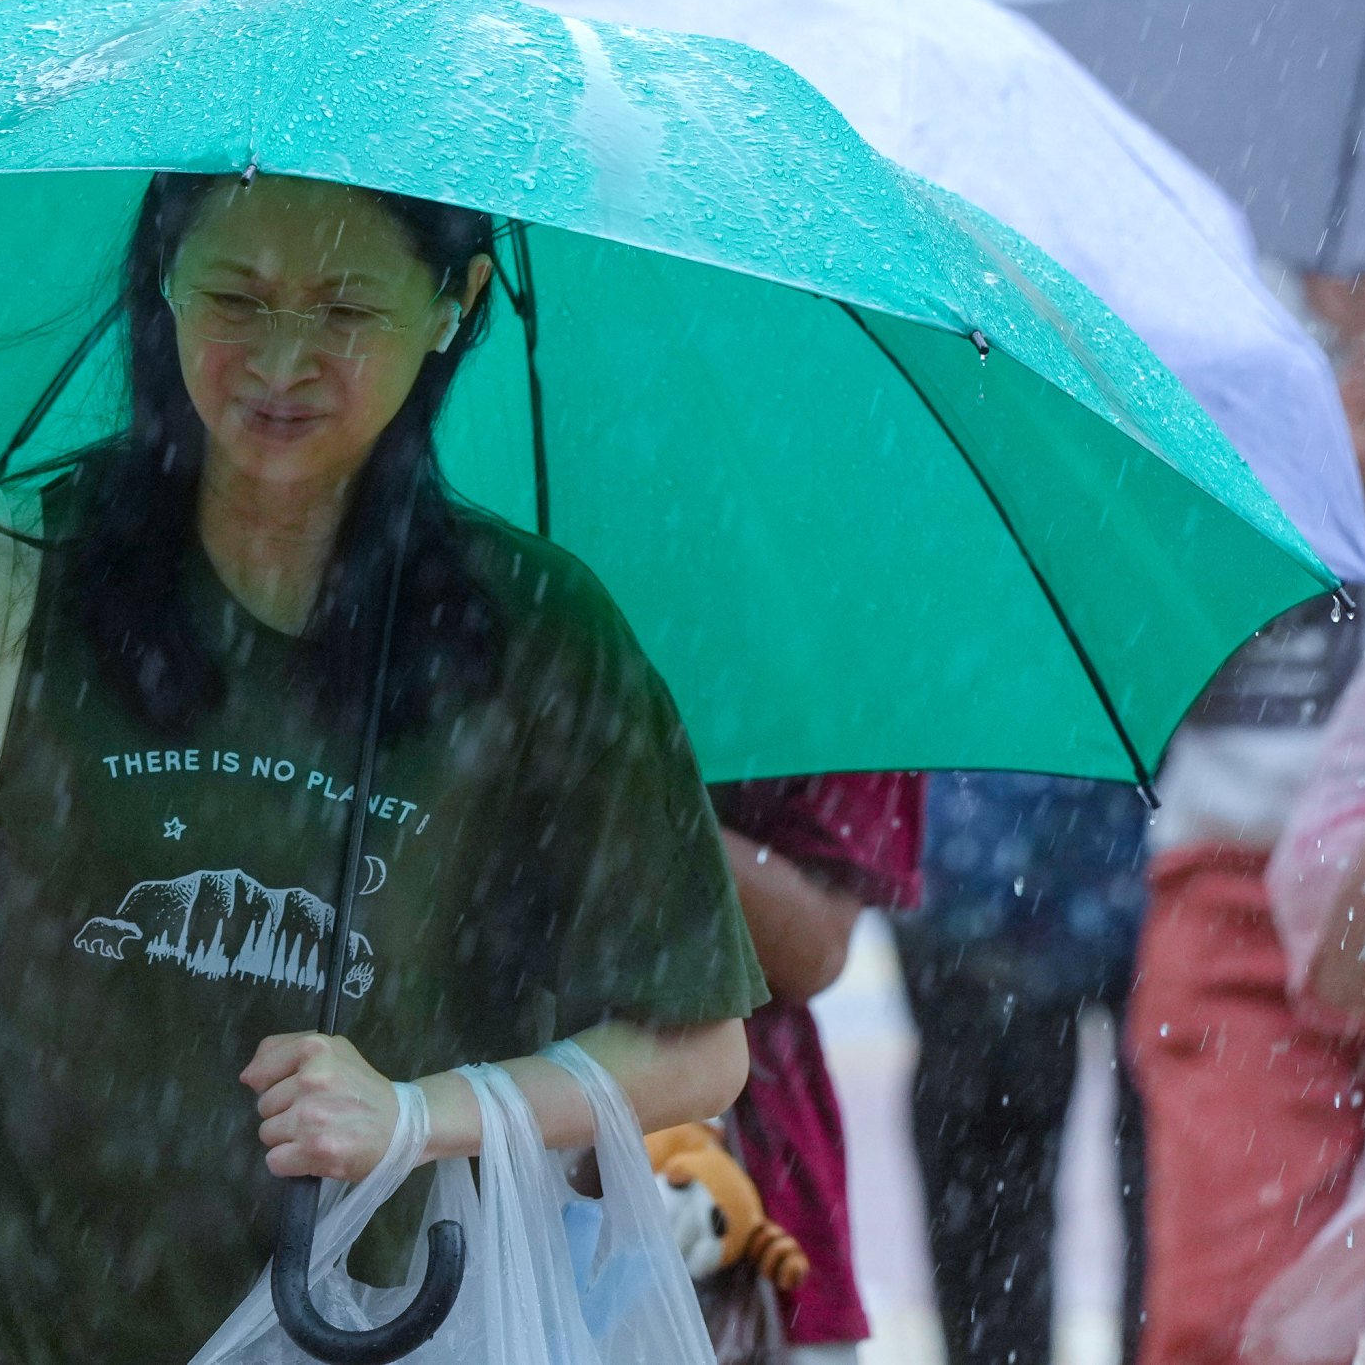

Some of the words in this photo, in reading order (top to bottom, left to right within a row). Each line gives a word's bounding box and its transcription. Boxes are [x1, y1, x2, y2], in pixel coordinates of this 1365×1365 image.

[102, 749, 201, 779] THERE
[212, 750, 240, 773] IS
[251, 755, 296, 782] NO
